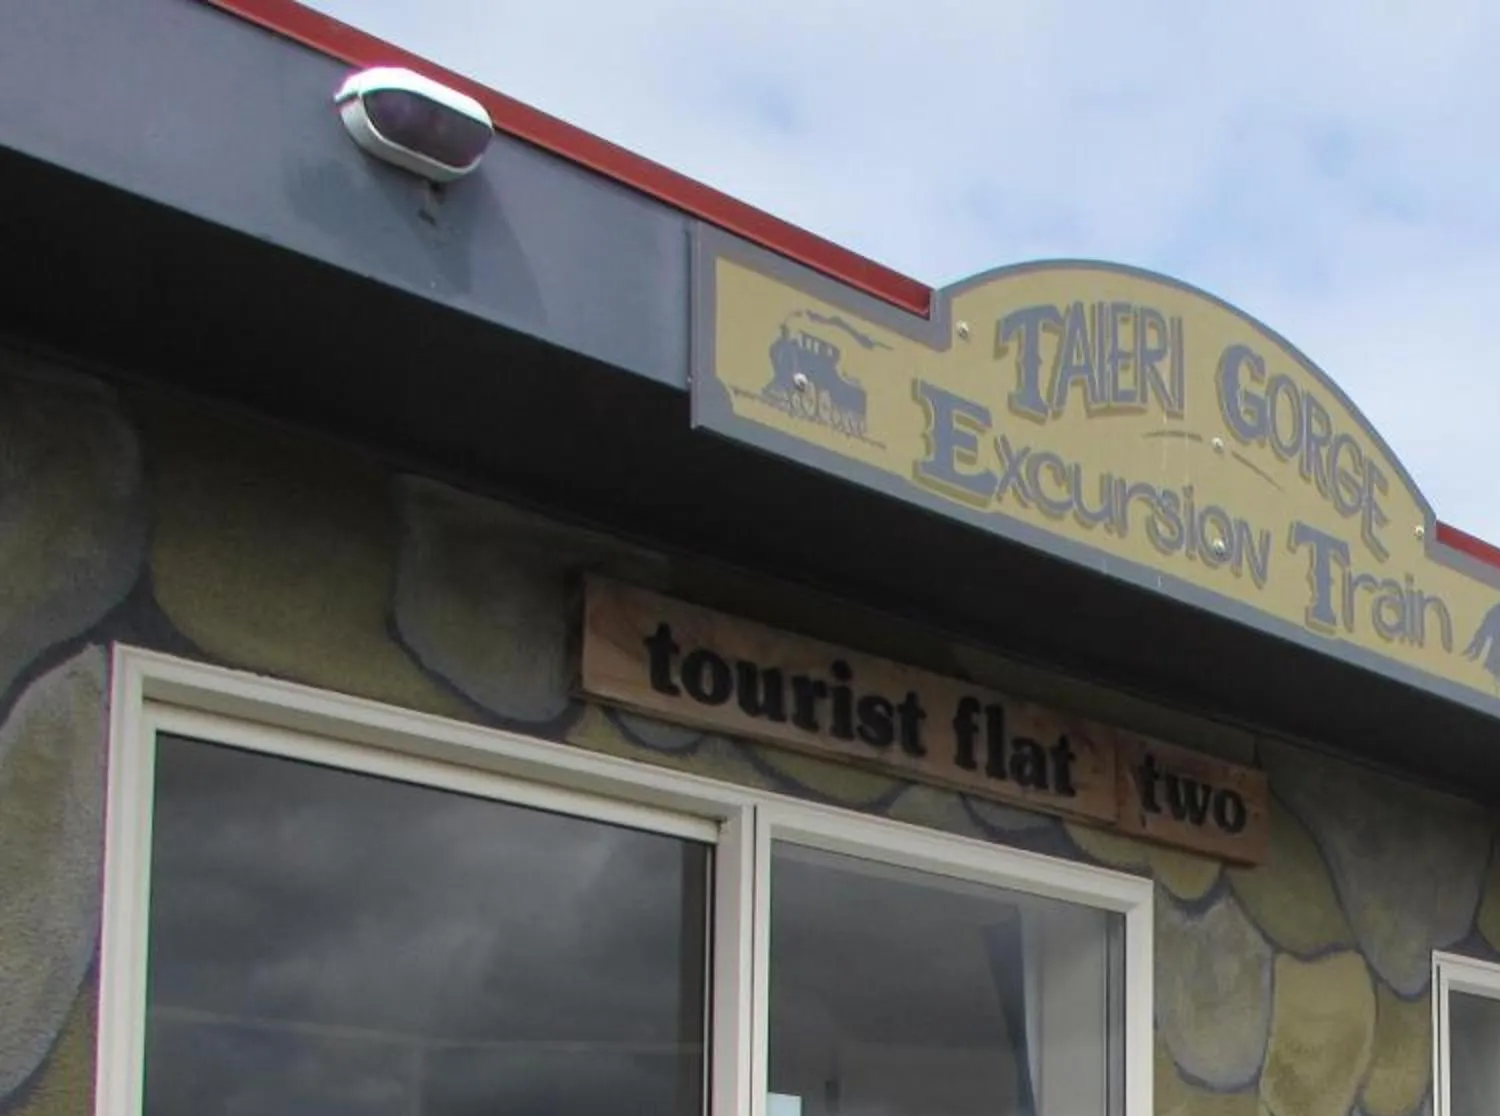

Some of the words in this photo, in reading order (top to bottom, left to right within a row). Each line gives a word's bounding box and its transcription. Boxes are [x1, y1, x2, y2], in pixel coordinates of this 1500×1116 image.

[992, 299, 1186, 424] TAIERI
[1216, 343, 1393, 562] GORGE
[1289, 519, 1456, 656] Train
[643, 620, 927, 760] tourist
[952, 696, 1077, 799] flat
[1134, 749, 1248, 836] two
